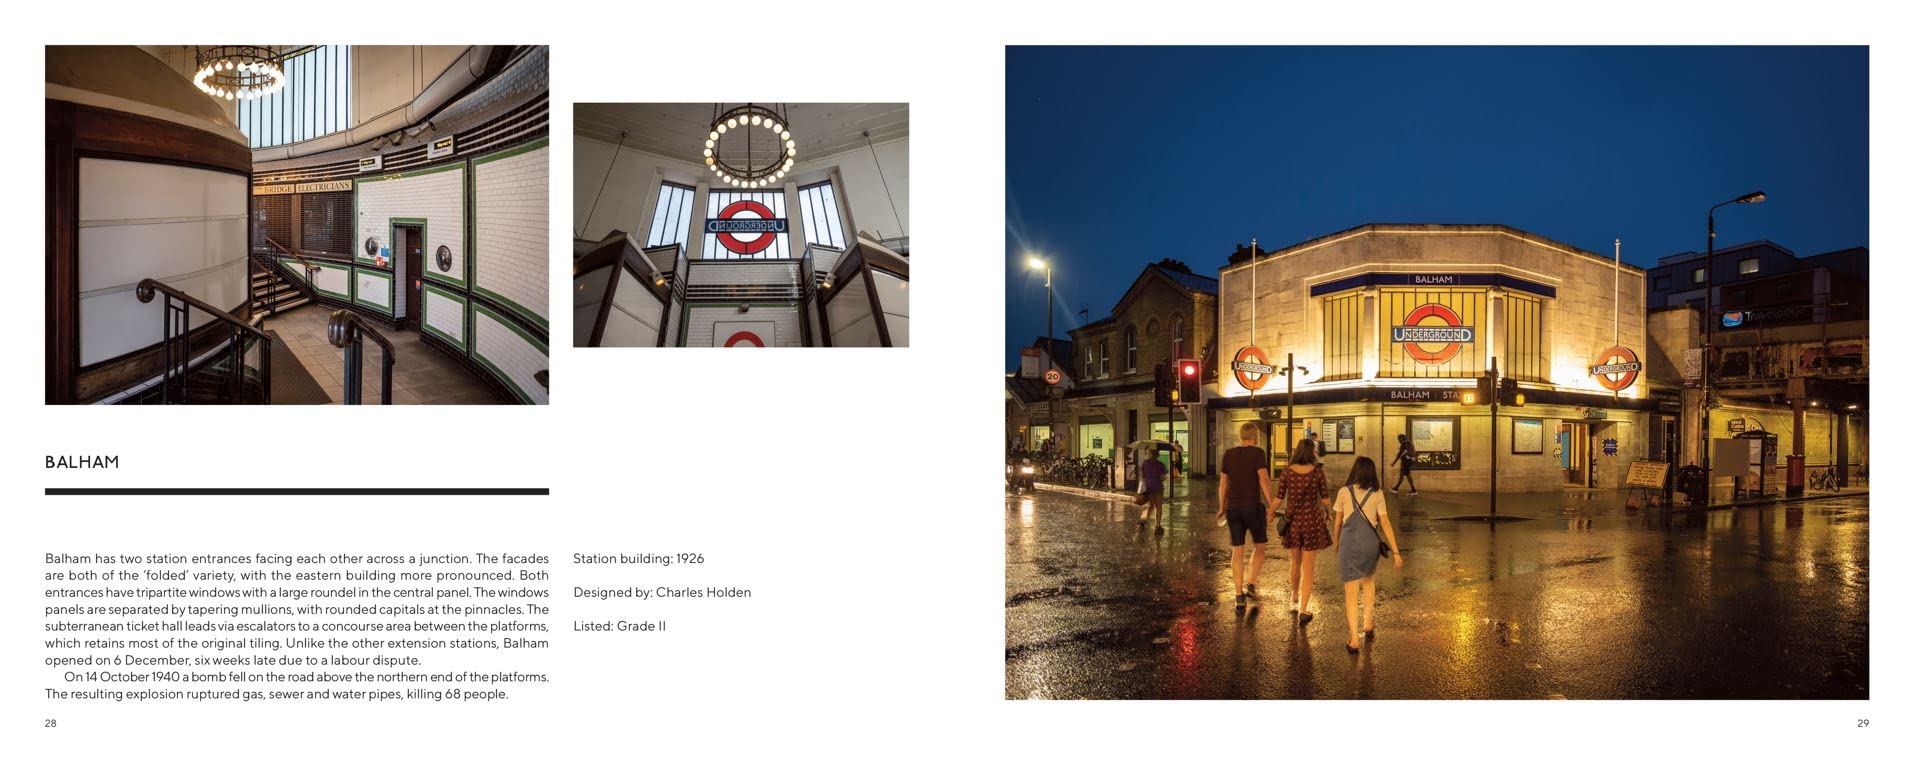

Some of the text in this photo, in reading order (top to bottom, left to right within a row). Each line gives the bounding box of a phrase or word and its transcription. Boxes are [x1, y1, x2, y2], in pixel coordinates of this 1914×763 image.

[298, 181, 350, 192] ELECTRICIANS
[1415, 275, 1453, 284] BALHAM
[1394, 328, 1472, 342] UNDERGROUND
[1391, 390, 1461, 399] BALHAM STA
[45, 455, 119, 469] BALHAM
[46, 553, 549, 567] Balham has two station entrances facing each other across a junction. The facades
[573, 553, 705, 567] Station building: 1926
[45, 572, 64, 581] are
[69, 570, 97, 581] both
[102, 569, 115, 581] of
[118, 570, 139, 581] the
[193, 570, 236, 583] variety,
[240, 570, 266, 581] with
[271, 570, 292, 581] the
[296, 571, 341, 581] eastern
[346, 570, 396, 583] building
[400, 572, 432, 581] more
[437, 570, 515, 583] pronounced.
[520, 569, 549, 581] Both
[45, 586, 549, 600] entrances have tripartite windows with a large roundel in the central panel. The windows
[574, 586, 751, 600] Designed by: Charles Holden
[45, 603, 549, 618] panels are separated by tapering mullions, with rounded capitals at the pinnacles. The
[45, 620, 549, 634] subterranean ticket hall leads via escalators to a concourse area between the platforms,
[574, 620, 666, 632] Listed: Grade II
[45, 637, 549, 651] which retains most of the original tiling. Unlike the other extension stations, Balham
[45, 654, 421, 668] opened on 6 December, six weeks late due to a labour dispute.
[64, 671, 549, 685] On 14 October 1940 a bomb fell on the road above the northern end of the platforms.
[45, 688, 509, 702] The resulting explosion ruptured gas, sewer and water pipes, killing 68 people.
[45, 719, 57, 728] 28
[1857, 719, 1870, 728] 29
